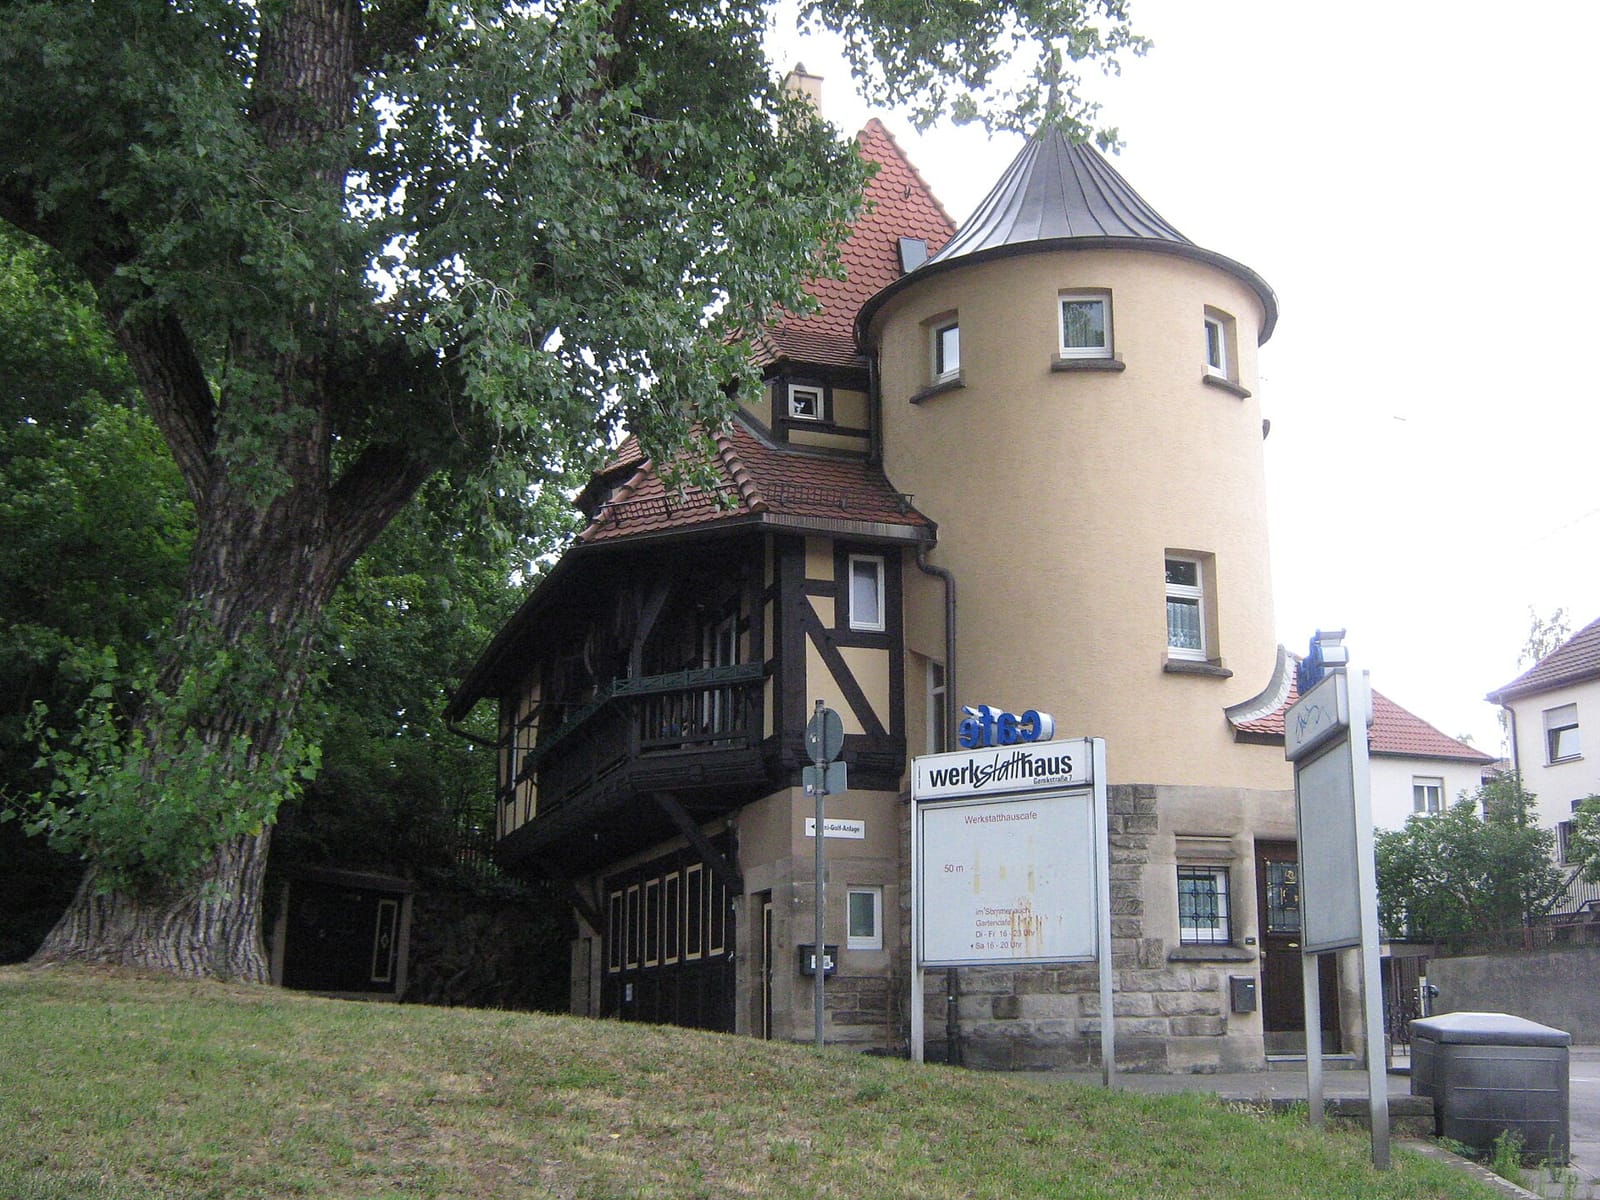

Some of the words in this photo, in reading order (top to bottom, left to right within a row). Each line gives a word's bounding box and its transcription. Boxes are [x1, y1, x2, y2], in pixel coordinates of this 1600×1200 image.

[929, 751, 1073, 788] werkstatthaus
[824, 824, 860, 834] ni-Golf-Anlage
[944, 864, 954, 873] 50
[975, 942, 985, 950] Sa
[1000, 941, 1009, 949] 20
